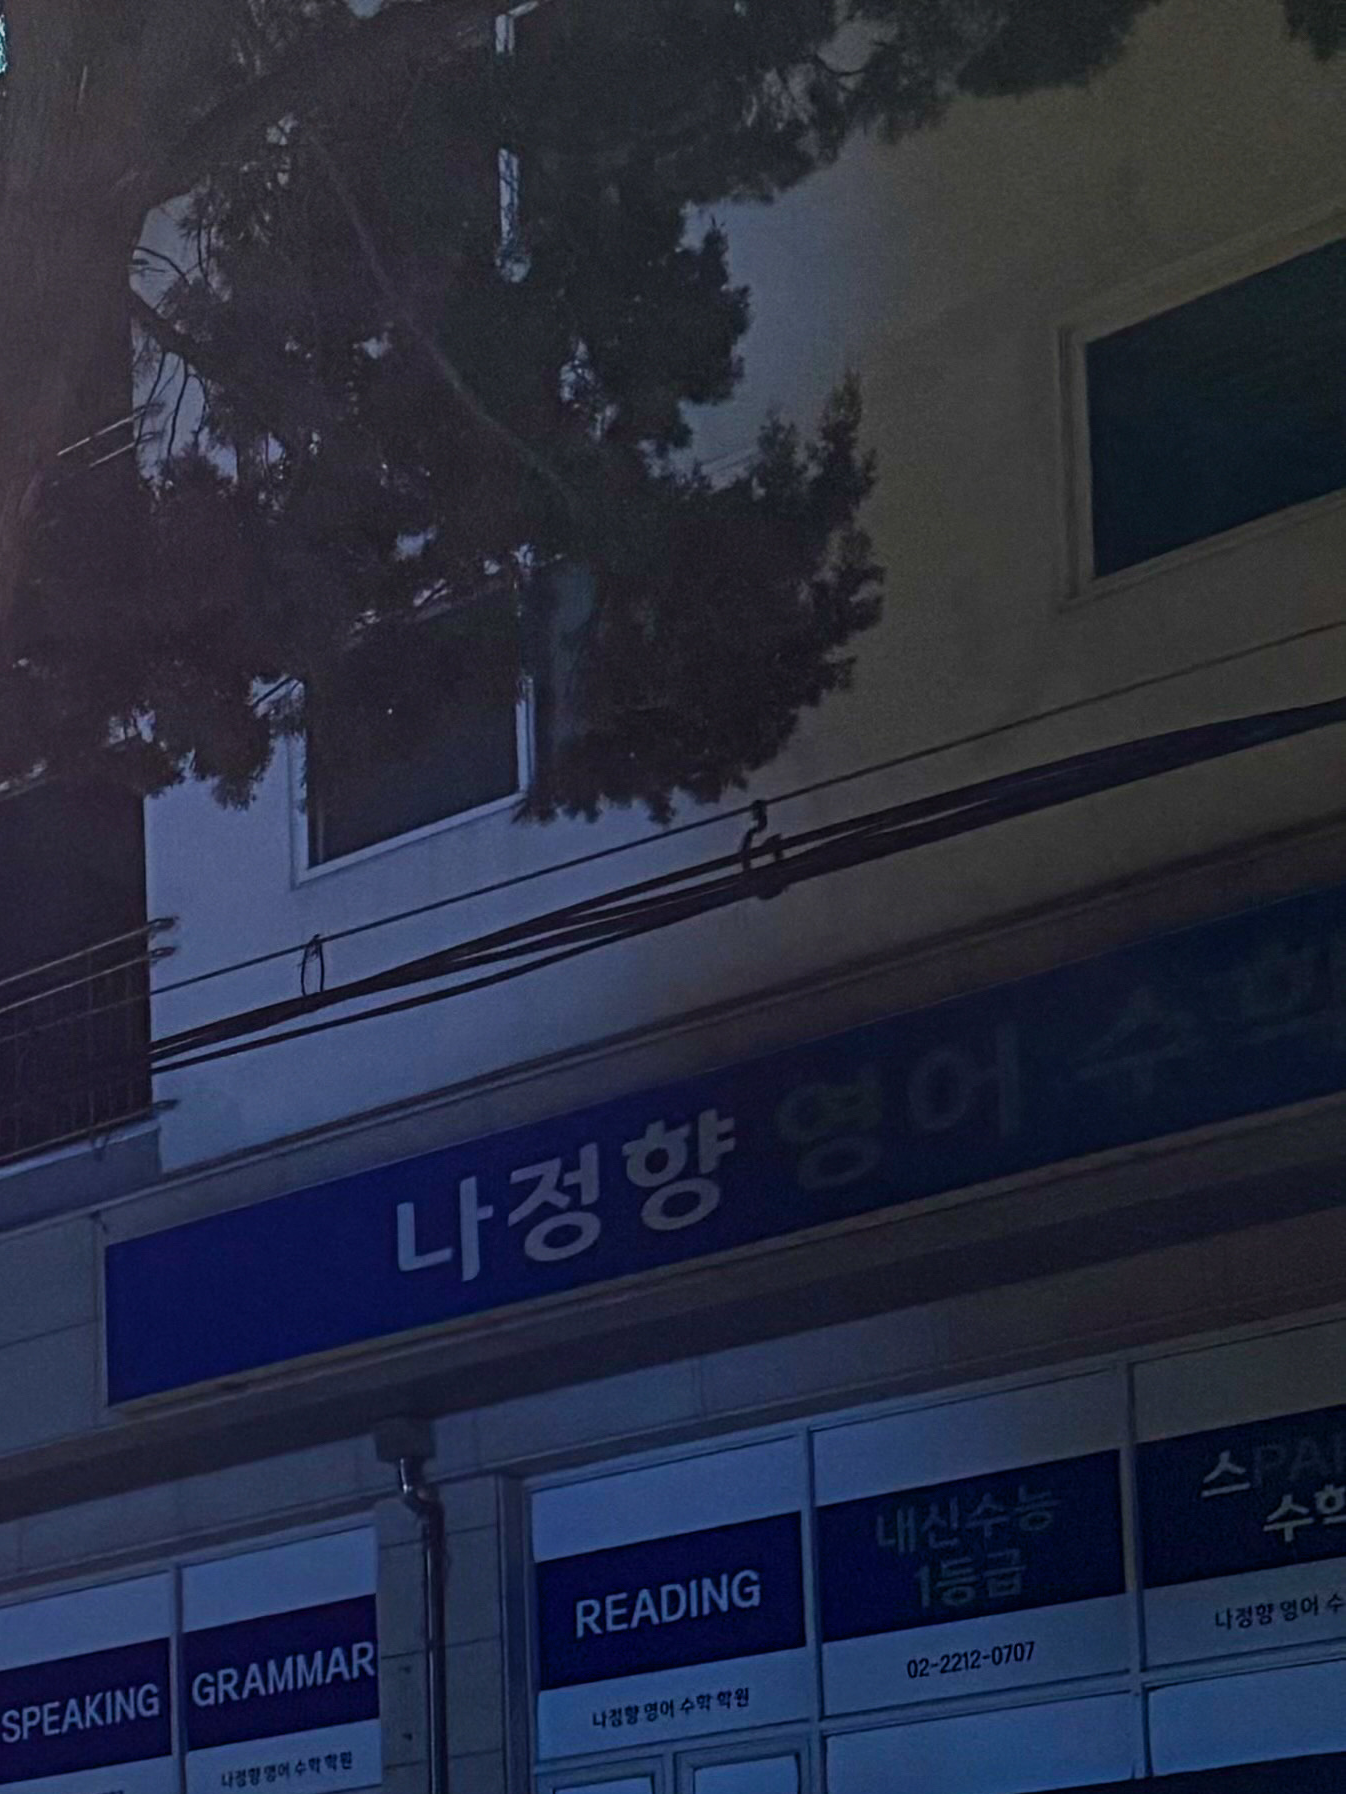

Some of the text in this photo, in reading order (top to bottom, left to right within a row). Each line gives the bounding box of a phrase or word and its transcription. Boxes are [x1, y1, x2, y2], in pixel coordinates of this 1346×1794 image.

[395, 1106, 736, 1283] 나정향
[774, 1020, 1023, 1193] 영어
[875, 1485, 1062, 1555] 내신수능
[575, 1568, 762, 1639] READING
[914, 1547, 1027, 1609] 1등급
[1214, 1602, 1275, 1630] 나정향
[1279, 1593, 1319, 1622] 영어
[191, 1638, 376, 1709] GRAMMAR
[906, 1640, 1037, 1680] 02-2212-0707
[0, 1682, 162, 1745] SPEAKING
[592, 1705, 640, 1729] 나정향
